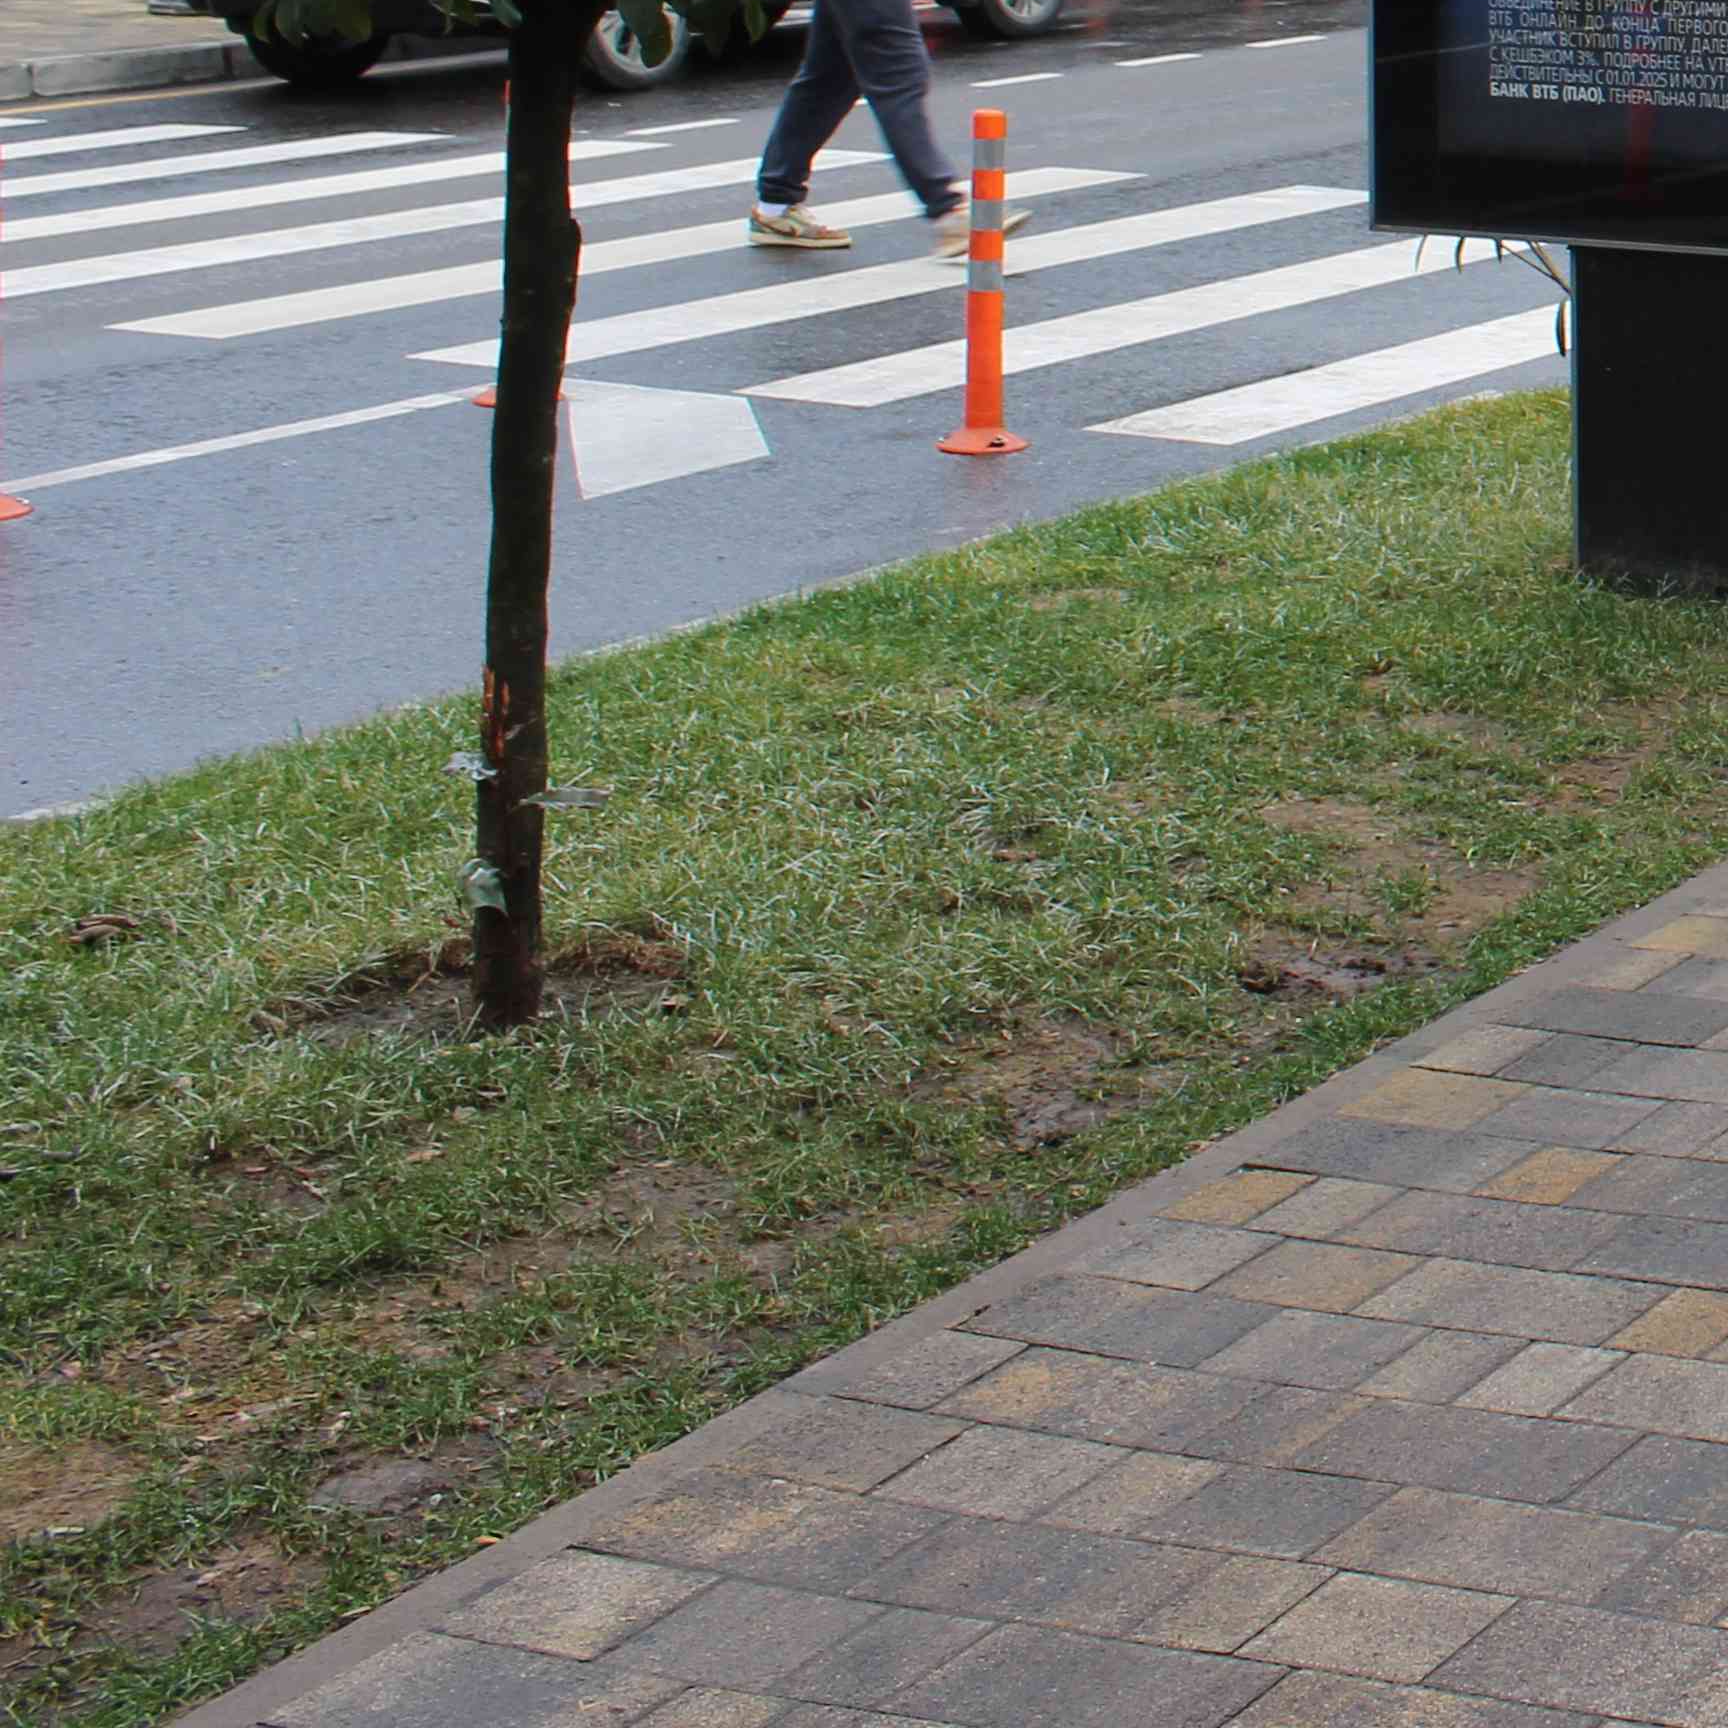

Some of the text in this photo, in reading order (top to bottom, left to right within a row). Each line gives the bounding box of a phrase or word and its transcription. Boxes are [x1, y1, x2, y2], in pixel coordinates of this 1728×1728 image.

[1597, 0, 1646, 16] ГРУППУ
[1650, 1, 1659, 16] С
[1662, 2, 1726, 19] ДРУГИМИ
[1488, 13, 1512, 28] ВТБ
[1519, 14, 1577, 30] ОНЛАЙН
[1583, 16, 1603, 31] ДО
[1612, 17, 1660, 34] КОНЦА
[1668, 20, 1728, 37] ПЕРВОГО
[1488, 31, 1555, 48] УЧАСТНИК
[1559, 34, 1619, 51] ВСТУПИЛ
[1623, 36, 1631, 52] В
[1489, 47, 1500, 63] С
[1502, 47, 1573, 66] КЕШБЭКОМ
[1603, 52, 1681, 71] ПОДРОБНЕЕ
[1684, 56, 1704, 72] НА
[1489, 64, 1593, 86] ДЕЙСТВИТЕЛЬНЫ
[1595, 69, 1604, 86] С
[1669, 73, 1679, 90] И
[1682, 73, 1726, 92] МОГУТ
[1490, 83, 1528, 100] БАНК
[1532, 85, 1559, 101] ВТБ
[1563, 87, 1605, 103] (ПАО).
[1609, 89, 1695, 108] ГЕНЕРАЛЬНАЯ
